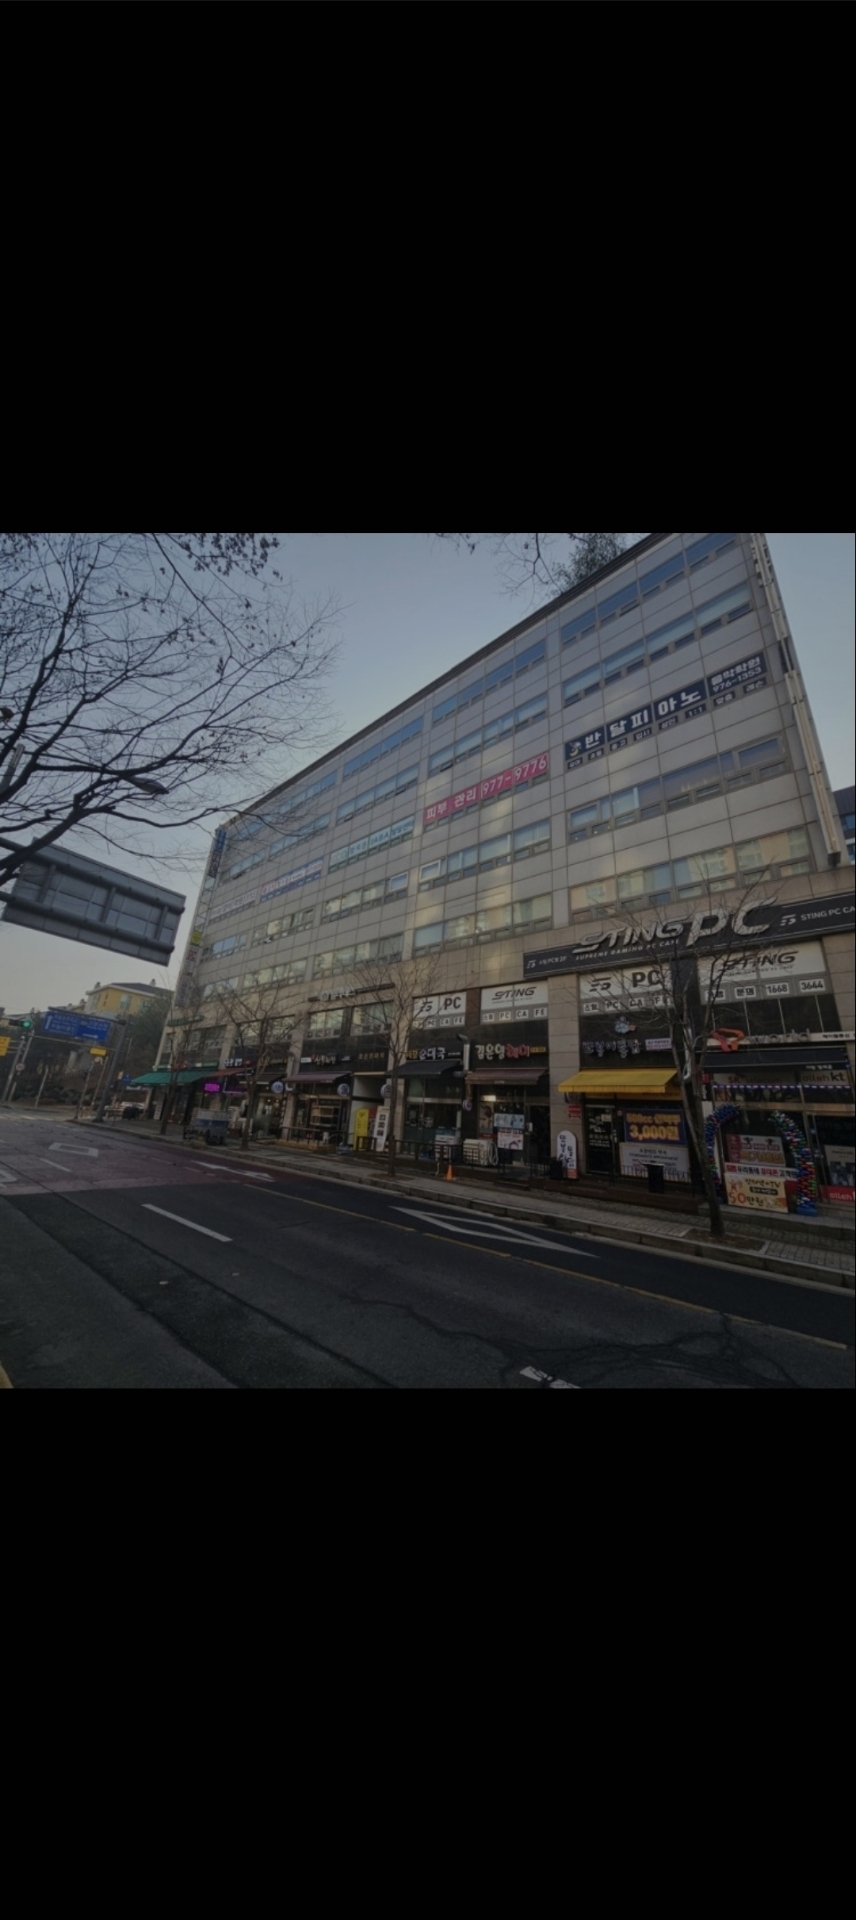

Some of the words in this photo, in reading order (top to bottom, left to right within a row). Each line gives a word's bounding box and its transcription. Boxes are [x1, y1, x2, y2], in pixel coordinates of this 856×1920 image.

[712, 666, 762, 693] 976-1353
[426, 801, 448, 819] 피부
[454, 787, 476, 807] 관리
[482, 758, 548, 795] 977-9776
[800, 910, 827, 921] STING
[828, 908, 841, 917] PC
[573, 917, 691, 954] STING
[685, 896, 779, 947] PC
[610, 945, 643, 956] GAMING
[718, 951, 799, 973] STING
[631, 970, 663, 988] PC
[767, 984, 788, 994] 1668
[801, 980, 824, 991] 3644
[492, 986, 537, 1001] STING
[444, 996, 462, 1011] PC
[830, 1072, 845, 1082] kt
[629, 1124, 680, 1142] 3,000원
